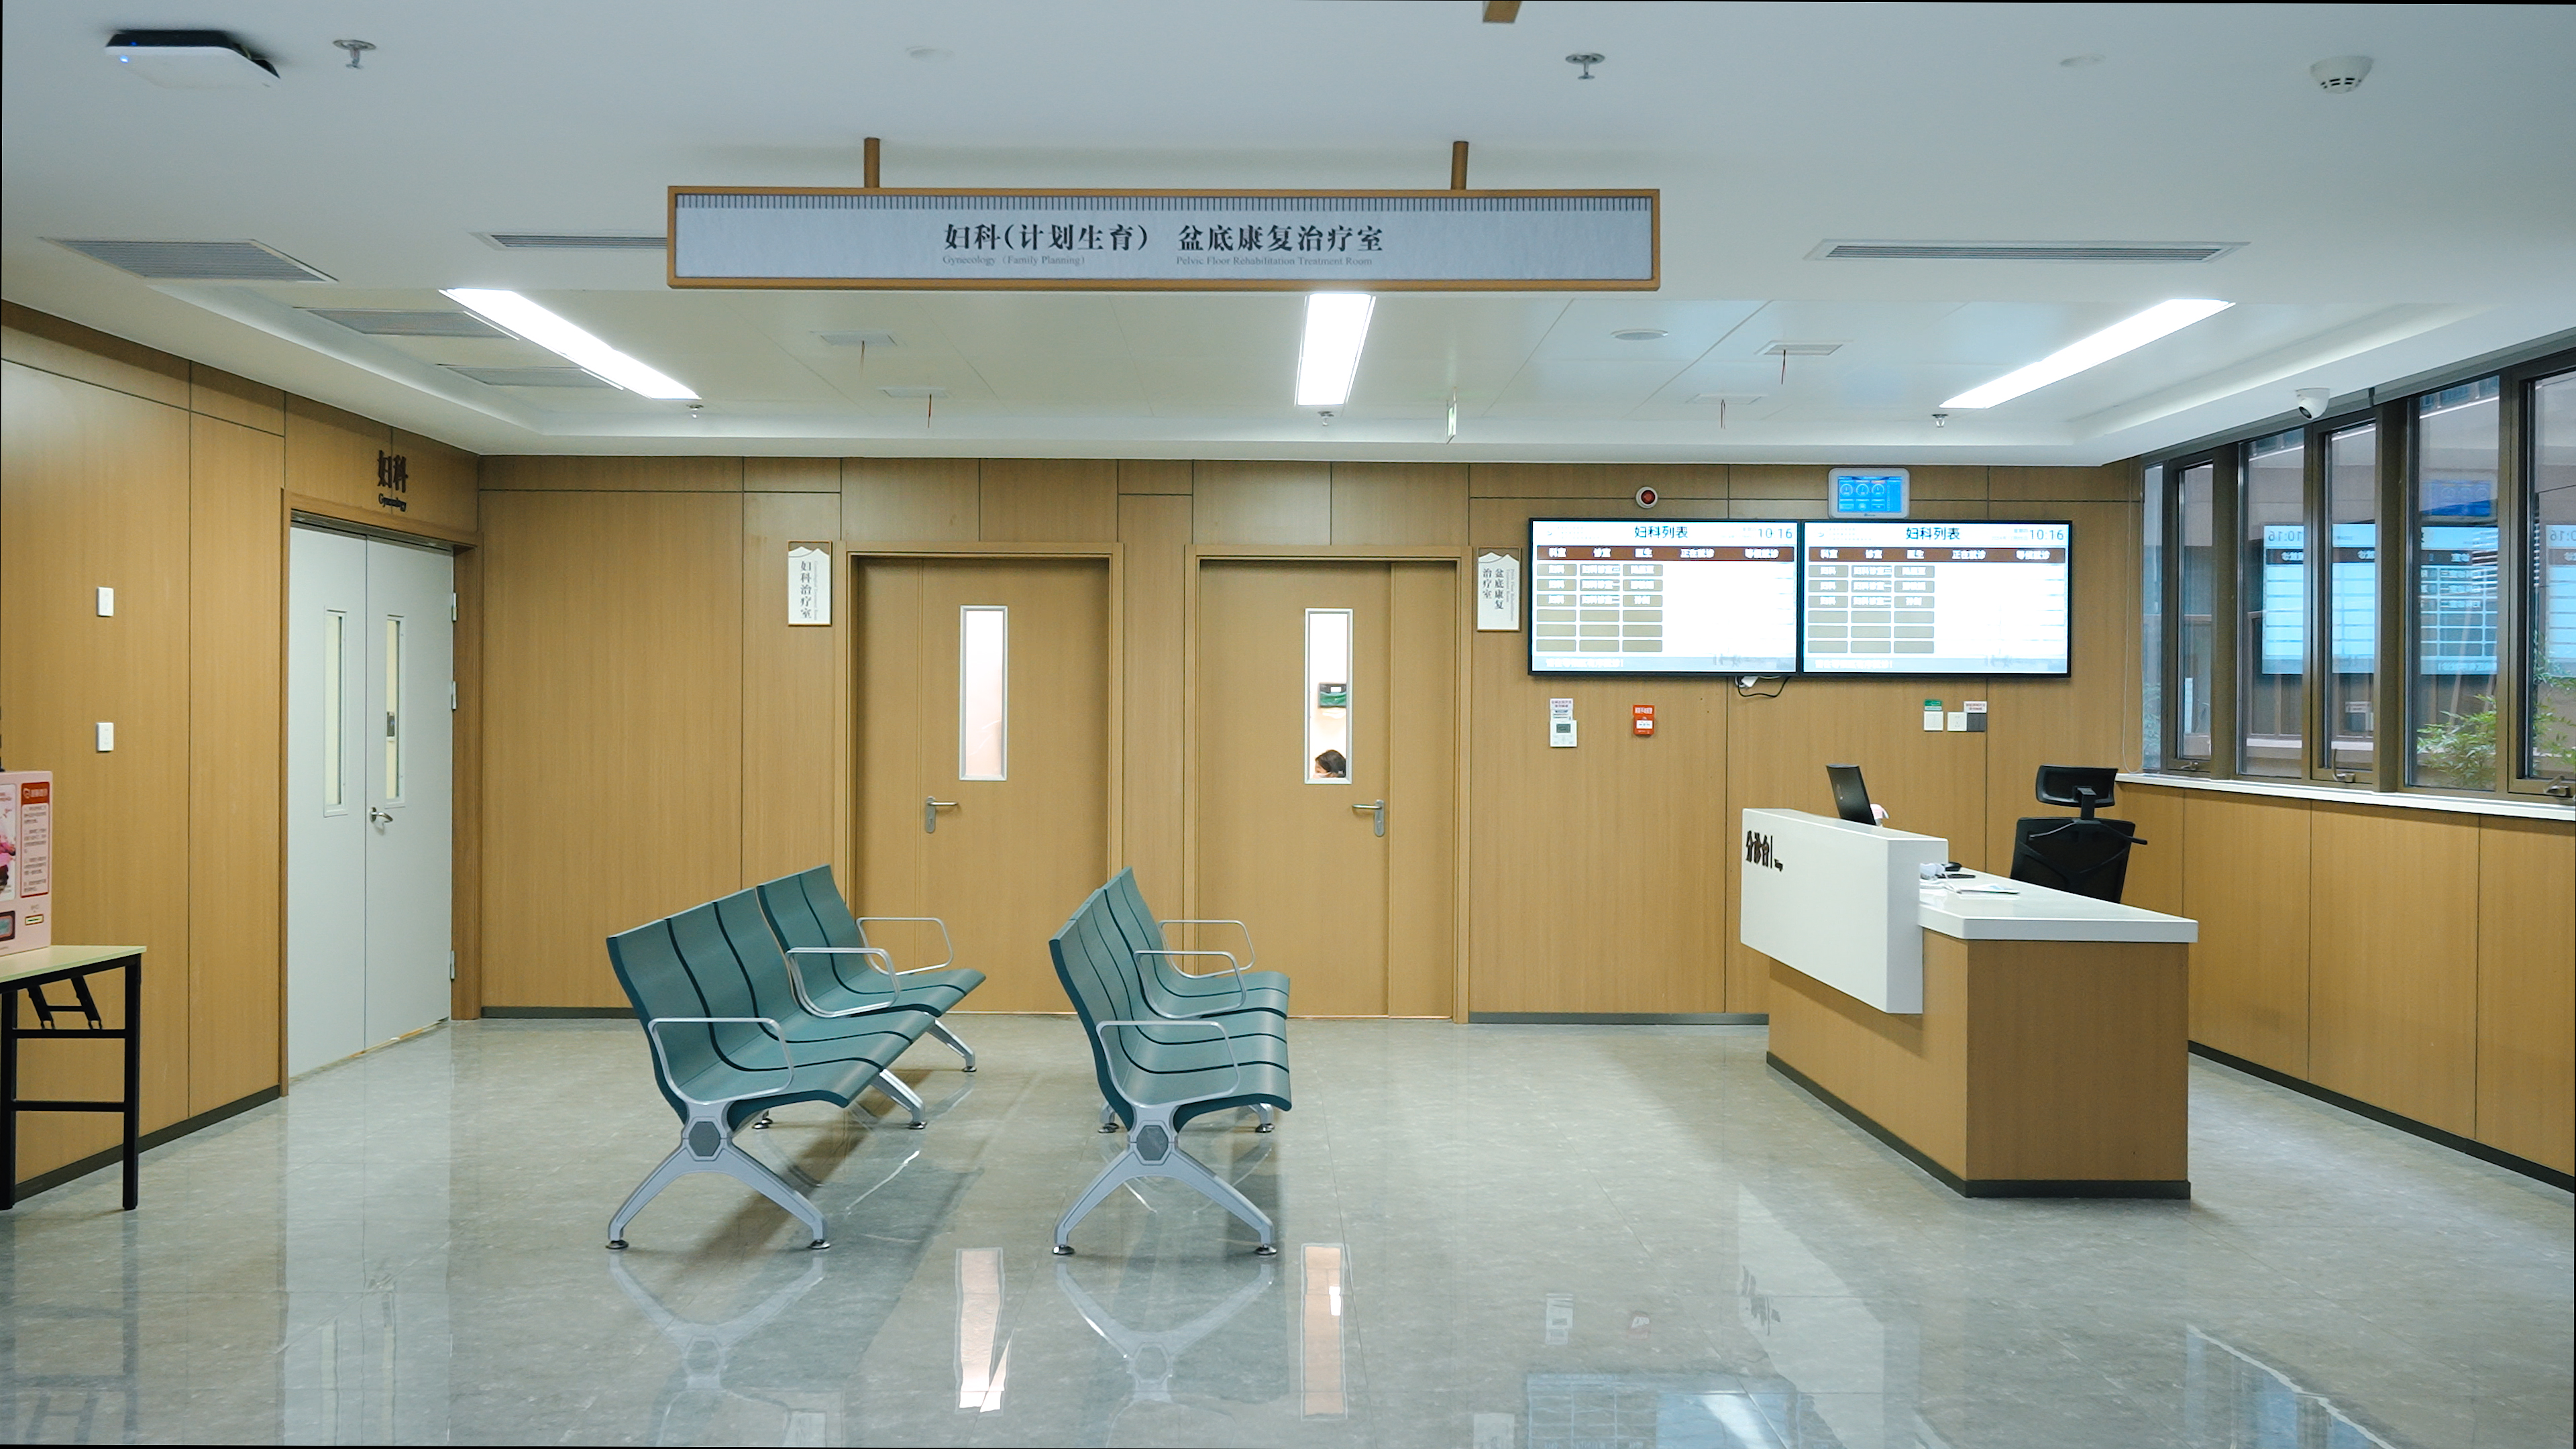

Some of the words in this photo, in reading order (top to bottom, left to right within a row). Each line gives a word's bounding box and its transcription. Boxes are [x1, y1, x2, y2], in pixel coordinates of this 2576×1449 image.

[1178, 224, 1383, 252] 盆底康复治疗室
[943, 255, 996, 266] Gynecology
[1176, 256, 1204, 266] Pelvic
[1207, 256, 1230, 266] Floor
[1233, 256, 1295, 266] Rehabilitation
[1298, 256, 1343, 266] Treatment
[1346, 256, 1373, 266] Room
[377, 449, 408, 493] 妇科
[1634, 525, 1689, 539] 妇科列表
[1758, 528, 1793, 539] 1016
[1906, 527, 1960, 540] 妇科列表
[2029, 529, 2064, 541] 10:16
[800, 561, 812, 618] 妇科治疗室
[1483, 568, 1493, 599] 治疗室
[1495, 568, 1504, 610] 盆底康复
